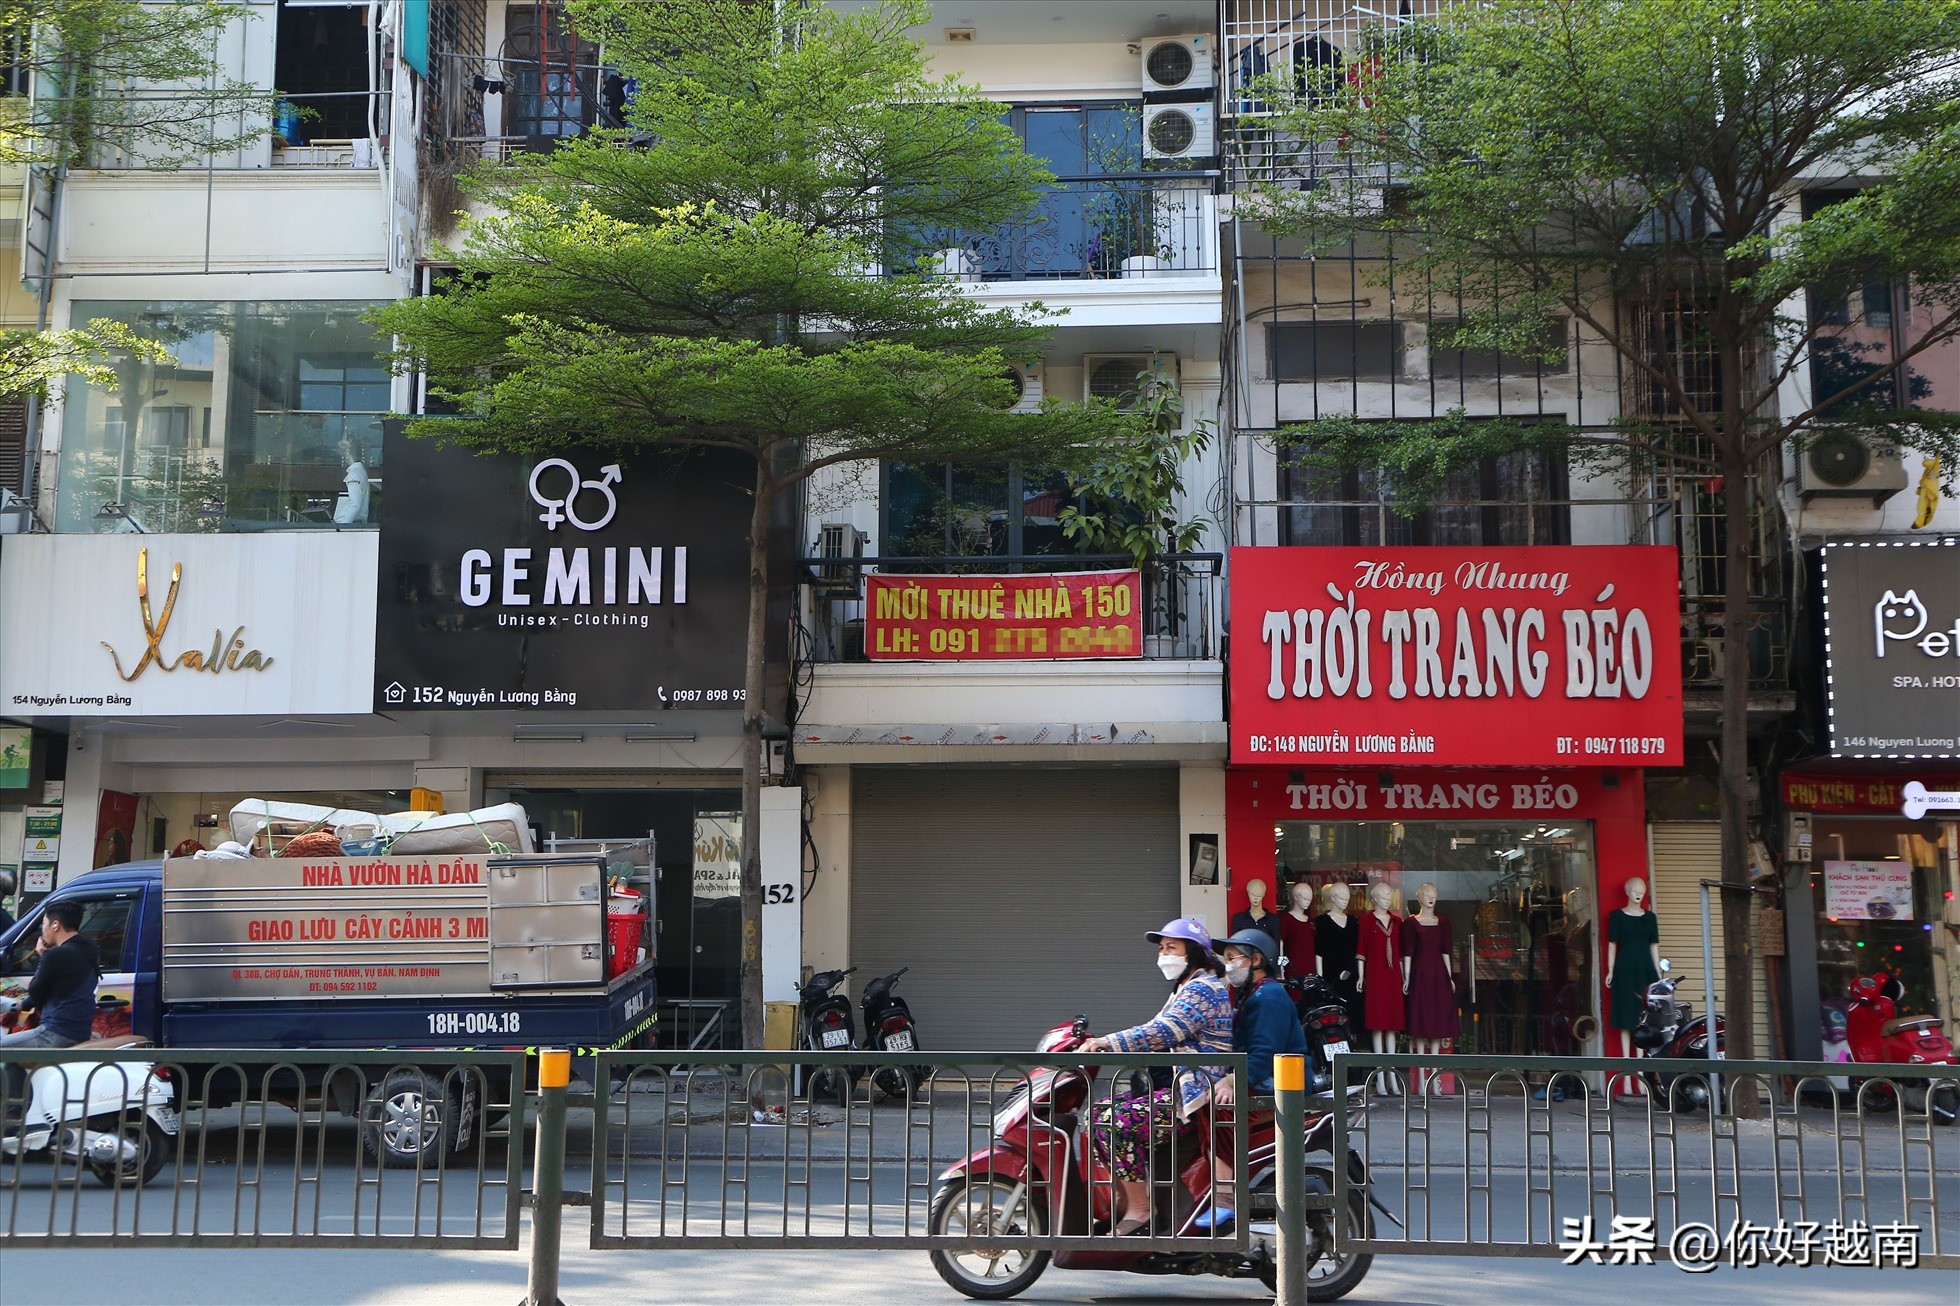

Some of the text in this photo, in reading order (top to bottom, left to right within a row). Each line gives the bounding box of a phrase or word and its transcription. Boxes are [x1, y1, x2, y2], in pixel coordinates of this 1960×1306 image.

[460, 546, 687, 607] GEMINI
[1354, 561, 1572, 597] Hồng Nhung
[876, 580, 1131, 620] MỜI THUÊ NHÀ 150
[498, 613, 557, 626] Unisex
[574, 613, 649, 628] Clothing
[876, 627, 920, 653] LH:
[929, 628, 979, 653] 091
[1262, 582, 1653, 700] THỜI TRANG BÉO
[12, 692, 132, 707] 154 Nguyễn Lương Bằng
[413, 686, 577, 706] 152 Nguyễn Lương Bằng
[673, 689, 746, 701] 0987 898 93
[1274, 735, 1296, 752] 148
[1299, 730, 1349, 752] NGUYỄN
[1355, 735, 1396, 753] LƯƠNG
[1400, 729, 1434, 753] BẰNG
[1585, 737, 1616, 753] 0947
[1619, 738, 1639, 754] 118
[1641, 737, 1665, 754] 979
[1843, 737, 1866, 747] 146
[1868, 736, 1914, 749] Nguyen
[1917, 736, 1954, 749] Luong
[1285, 775, 1578, 811] THỜI TRANG BÉO
[1789, 783, 1818, 809] PHỤ
[1821, 781, 1854, 808] KIỆN
[302, 856, 478, 886] NHÀ VƯỜN HÀ DẦN
[761, 884, 795, 905] 152
[248, 920, 293, 942] GIAO
[300, 919, 336, 940] LƯU
[345, 914, 383, 940] CÂY
[389, 910, 442, 939] CẢNH
[448, 917, 460, 938] 3
[264, 968, 281, 981] CHỢ
[304, 968, 331, 979] TRUNG
[364, 968, 375, 980] VỤ
[398, 968, 418, 977] NAM
[420, 968, 440, 979] ĐỊNH
[323, 983, 338, 991] 094
[340, 983, 356, 991] 592
[357, 982, 378, 991] 1102
[427, 1012, 521, 1034] 18H-004.18
